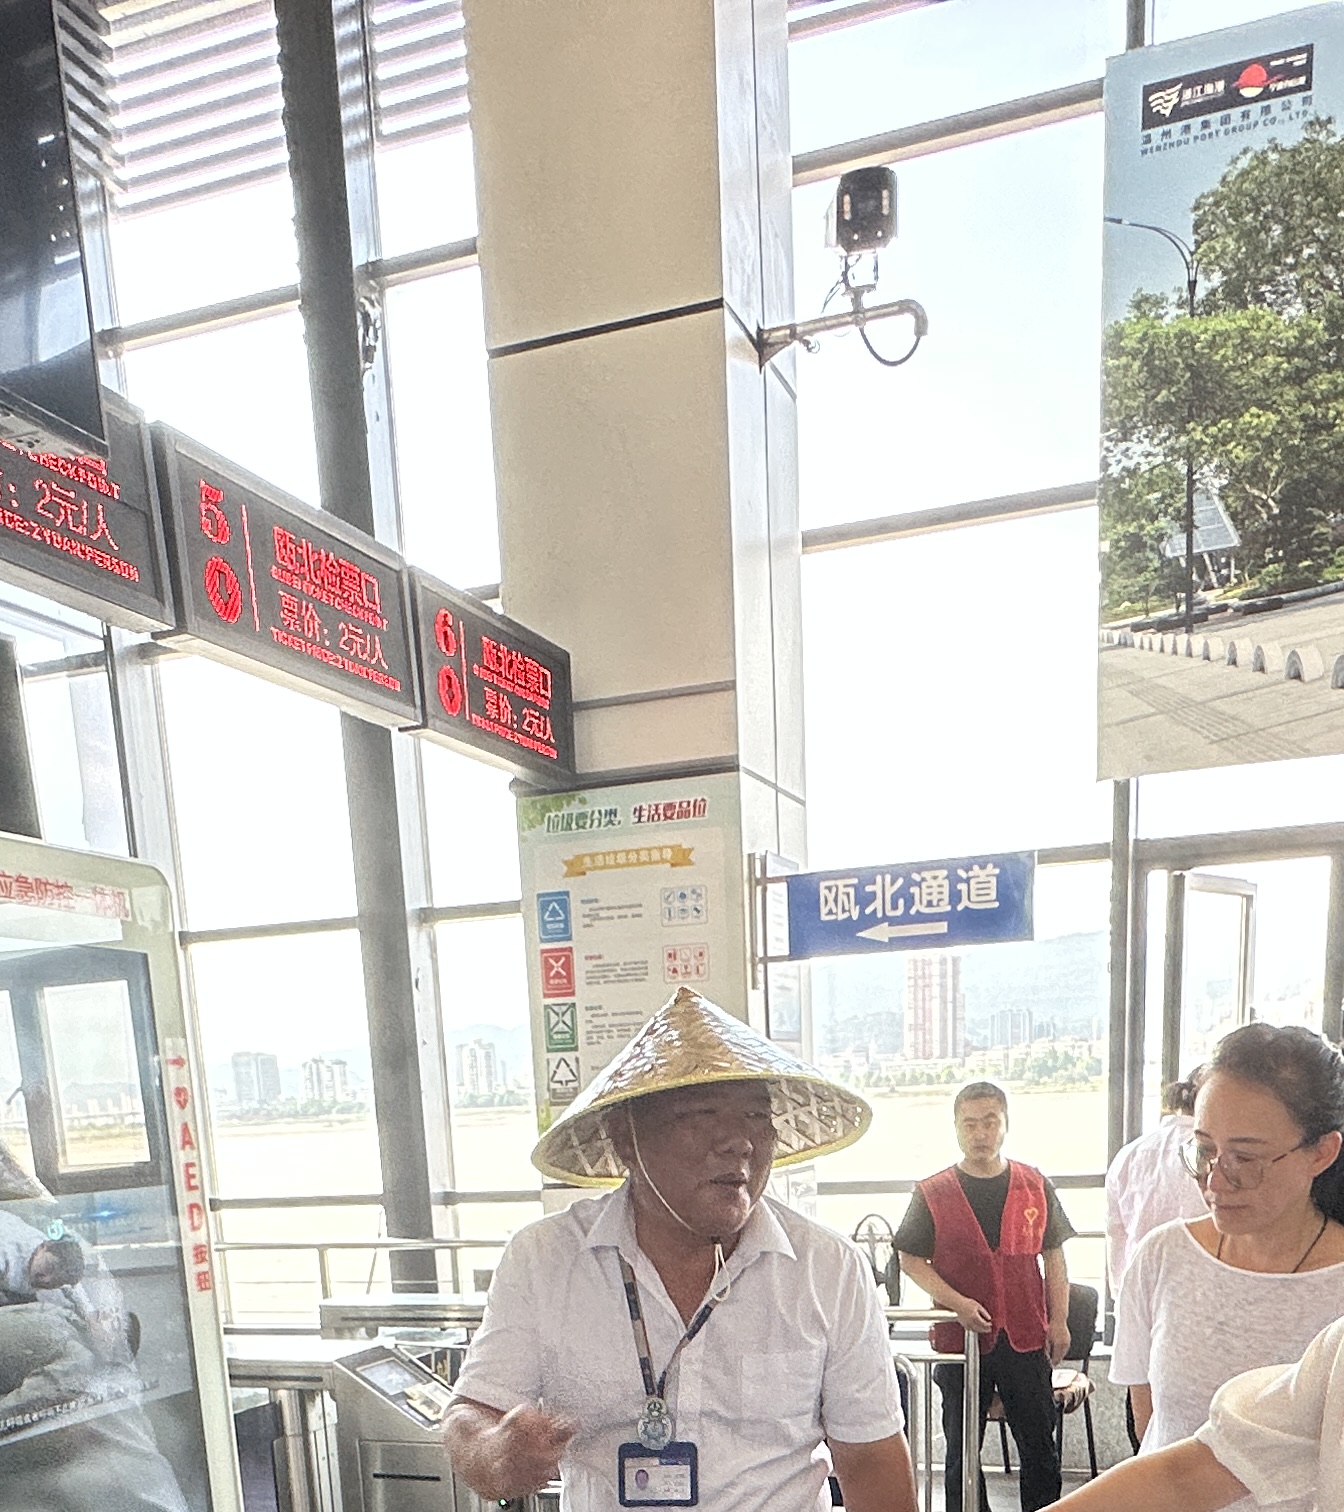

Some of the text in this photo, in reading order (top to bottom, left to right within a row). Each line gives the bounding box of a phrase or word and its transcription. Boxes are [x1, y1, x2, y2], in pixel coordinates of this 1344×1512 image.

[199, 479, 230, 544] 5
[273, 526, 382, 614] 瓯北检票口
[434, 608, 457, 657] 6
[819, 863, 1001, 923] 瓯北通道
